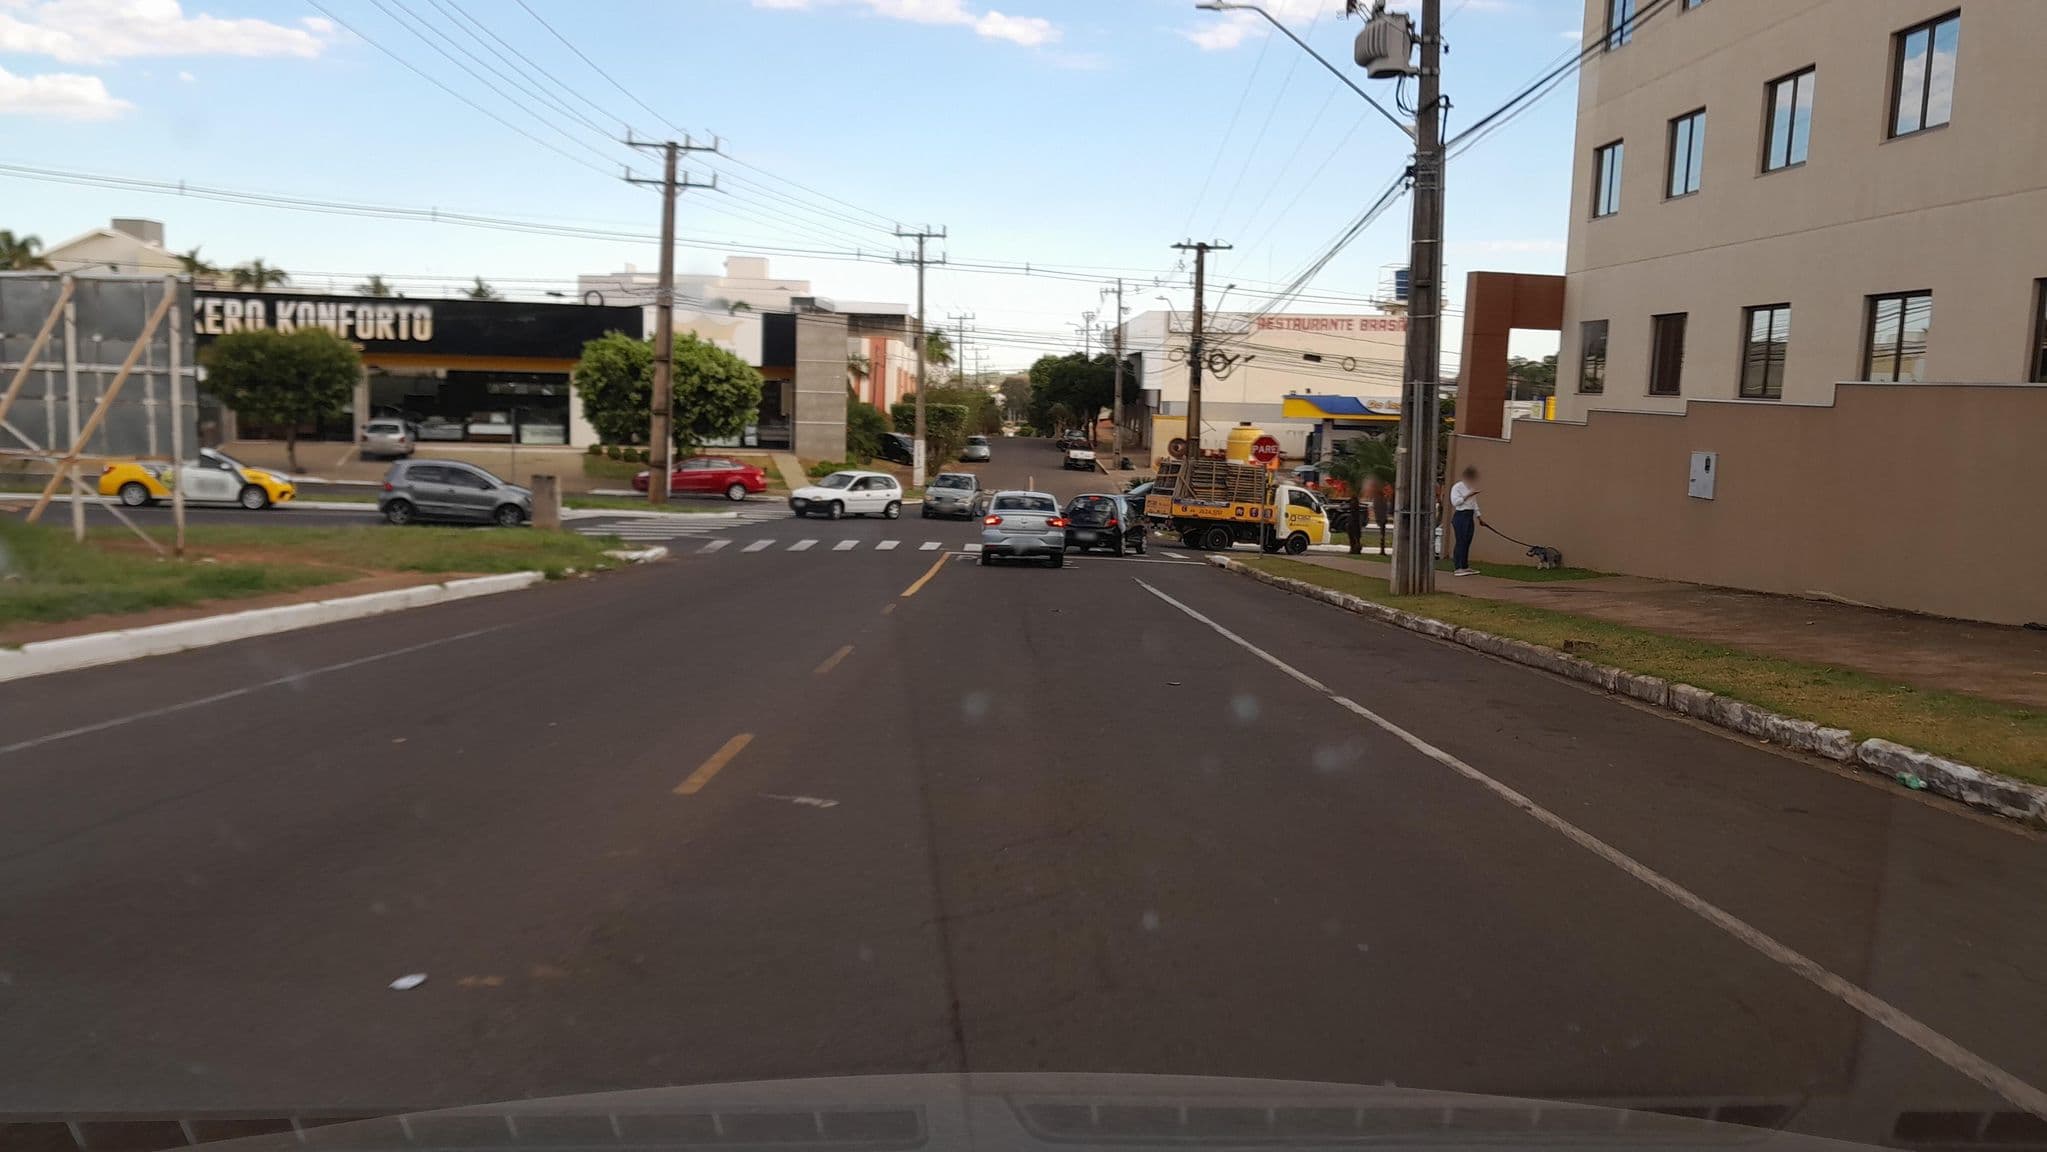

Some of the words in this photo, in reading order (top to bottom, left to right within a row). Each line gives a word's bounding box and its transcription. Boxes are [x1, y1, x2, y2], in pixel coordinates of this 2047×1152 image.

[276, 300, 433, 341] KONFORTO
[1257, 316, 1353, 331] RESTAURANTE
[1252, 444, 1279, 454] PARE
